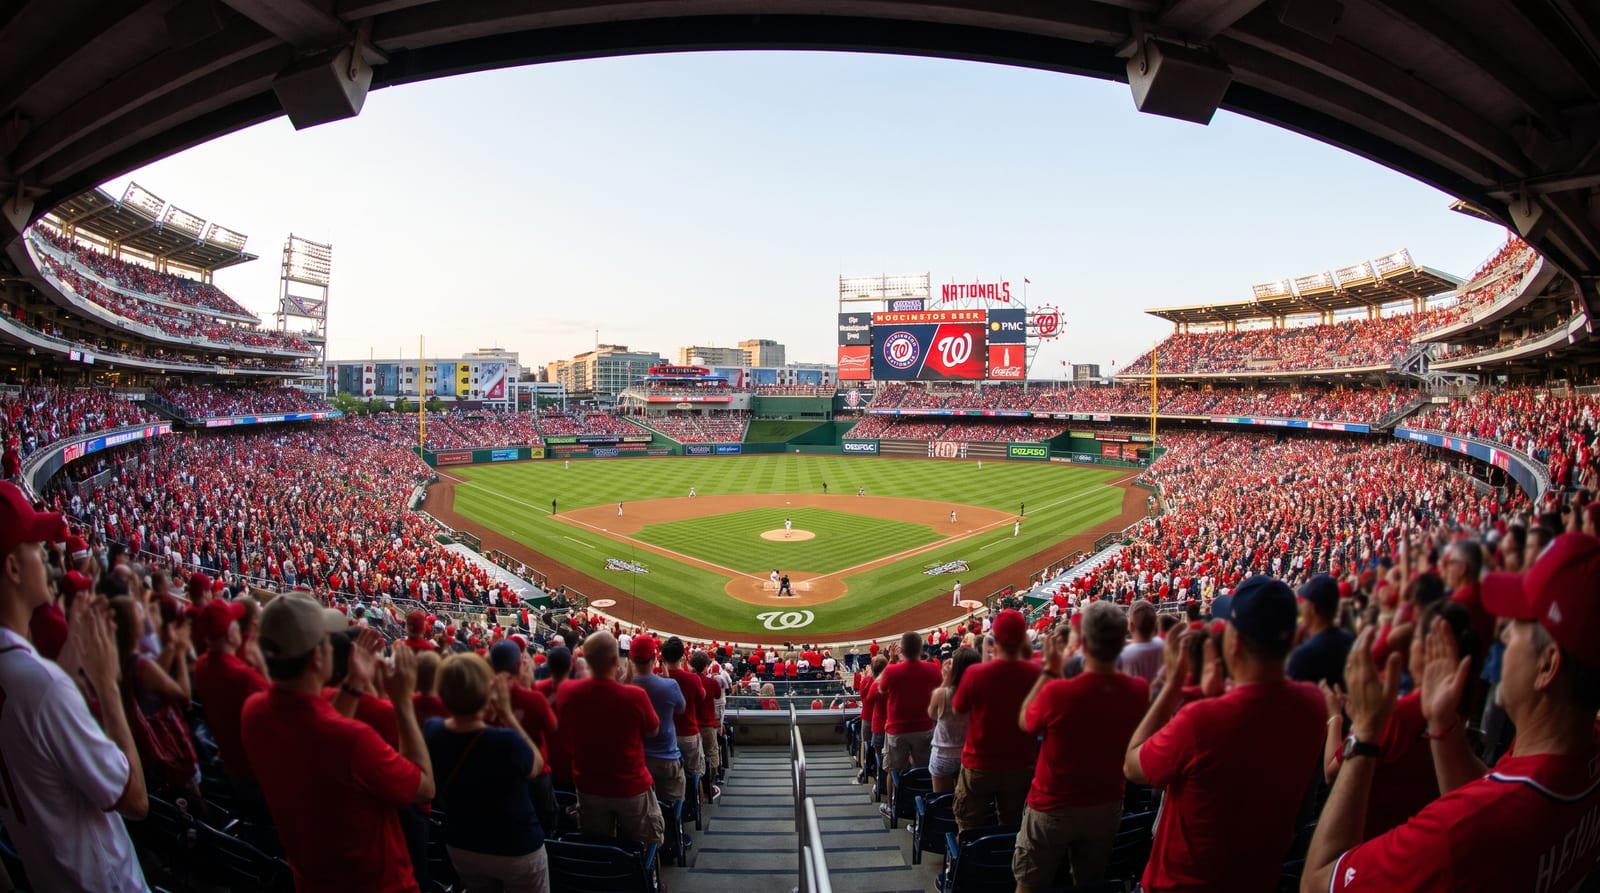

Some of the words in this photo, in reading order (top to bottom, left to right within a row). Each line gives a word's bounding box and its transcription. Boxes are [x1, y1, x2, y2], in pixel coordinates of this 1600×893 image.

[942, 281, 1010, 303] NATIONALS
[1001, 321, 1024, 331] PMC
[1037, 312, 1058, 334] W
[893, 341, 909, 359] W
[938, 332, 973, 368] W
[756, 610, 815, 631] W
